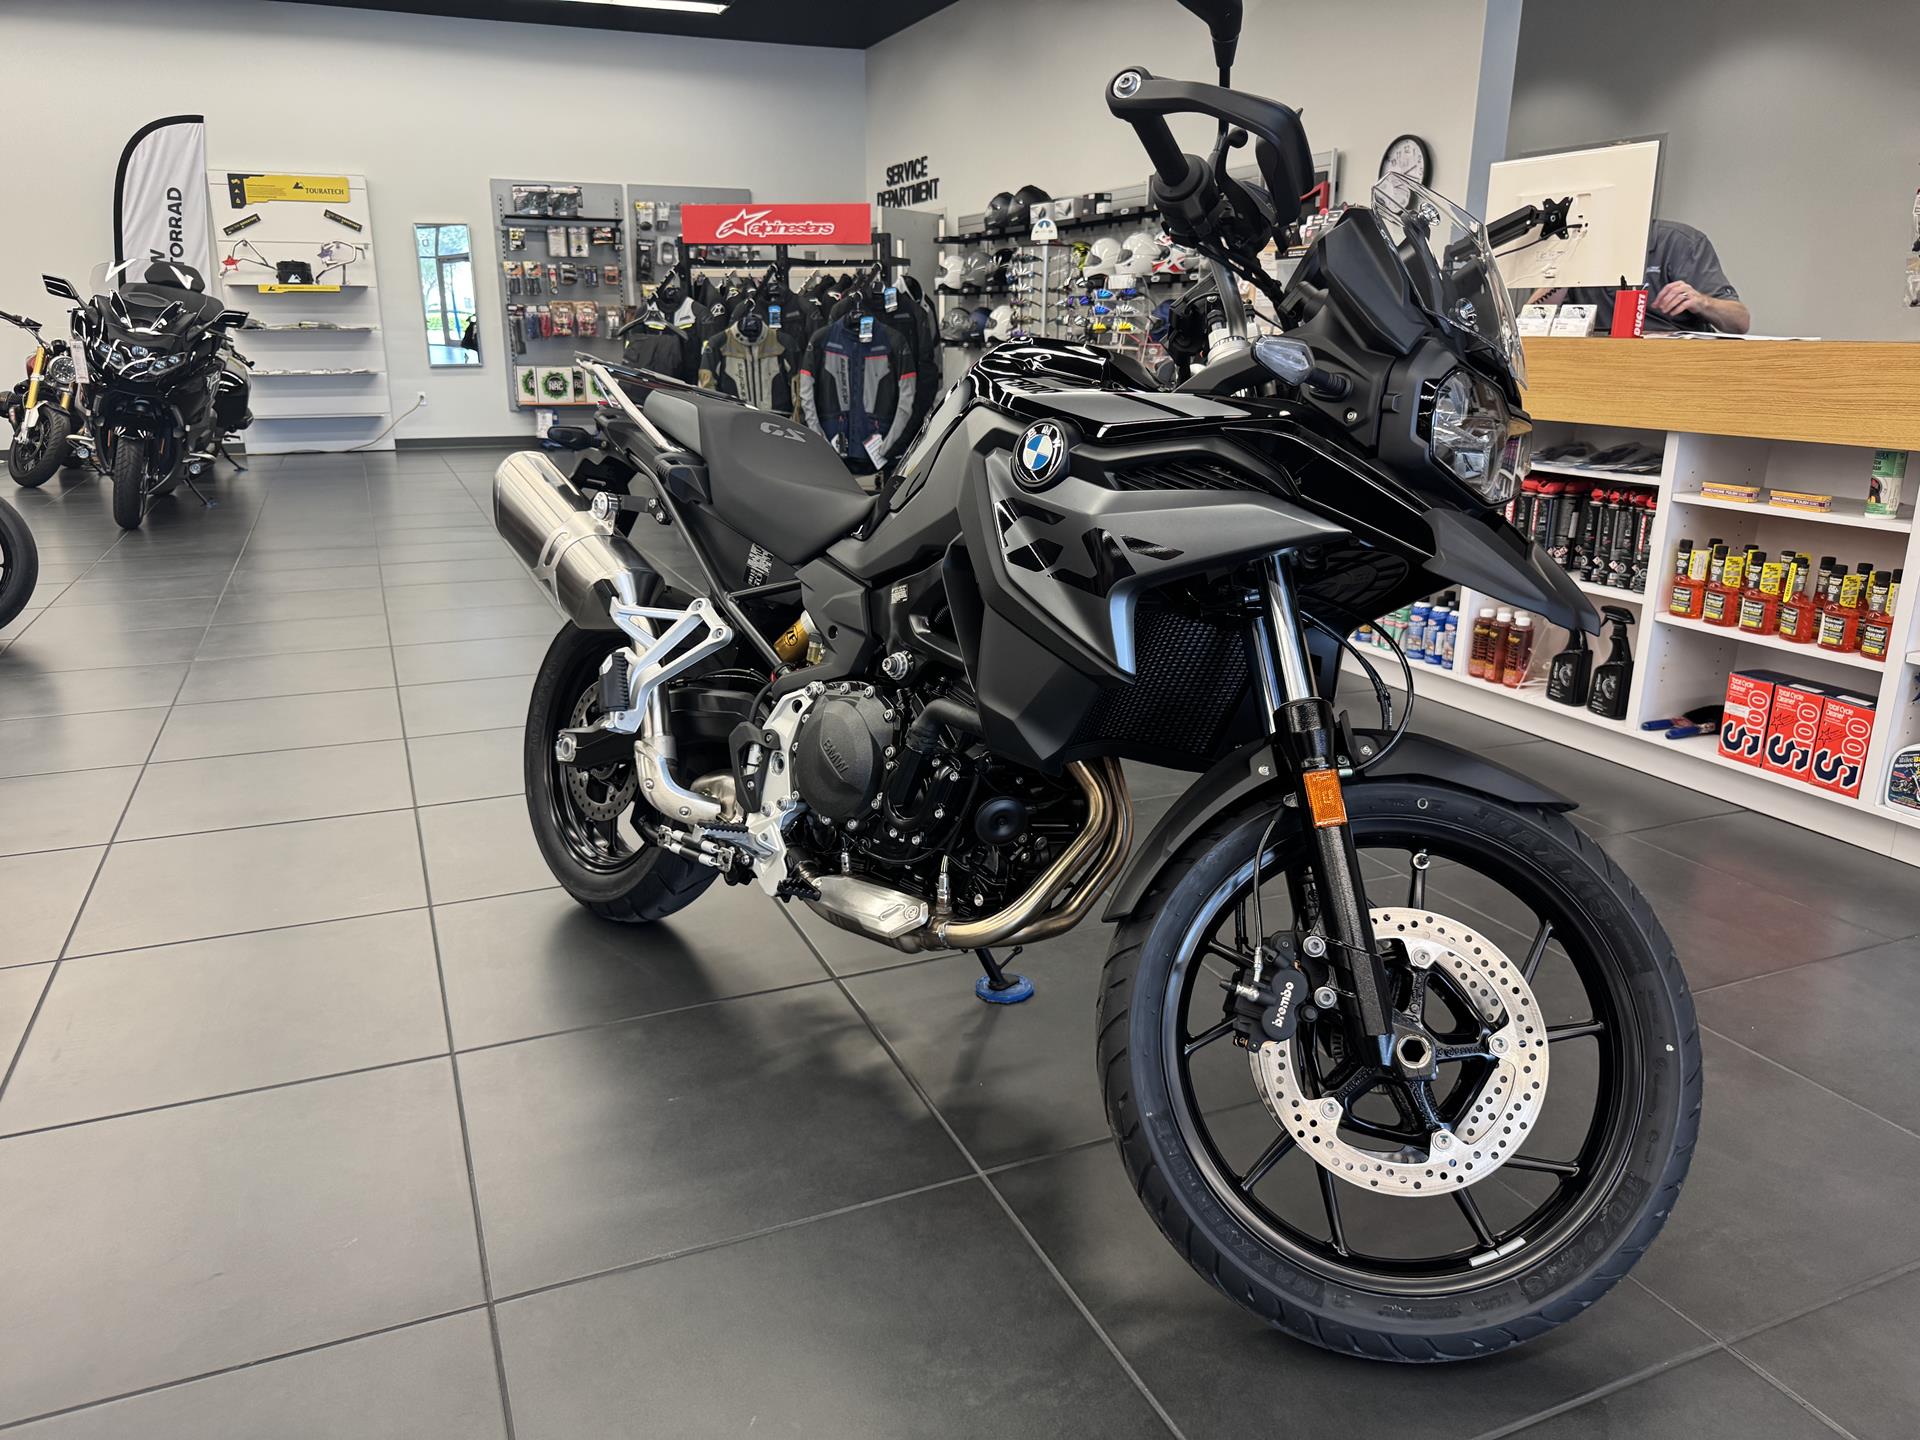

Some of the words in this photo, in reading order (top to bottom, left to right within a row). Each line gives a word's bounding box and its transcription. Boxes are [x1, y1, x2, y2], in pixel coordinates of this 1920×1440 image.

[886, 155, 928, 187] SERVICE
[305, 187, 344, 195] TOURATECH
[876, 177, 940, 208] DEPARTMENT
[749, 221, 835, 238] alpinestars
[1633, 293, 1646, 337] DUCATI
[1027, 425, 1061, 448] BMW
[1778, 689, 1790, 697] Total
[1790, 692, 1804, 701] Cycle
[1828, 703, 1840, 711] Total
[1839, 706, 1854, 716] Cycle
[1721, 690, 1770, 758] S100
[1765, 702, 1820, 773] S100
[823, 738, 849, 774] BMW
[1812, 717, 1871, 790] S100
[1272, 981, 1295, 1028] brembo
